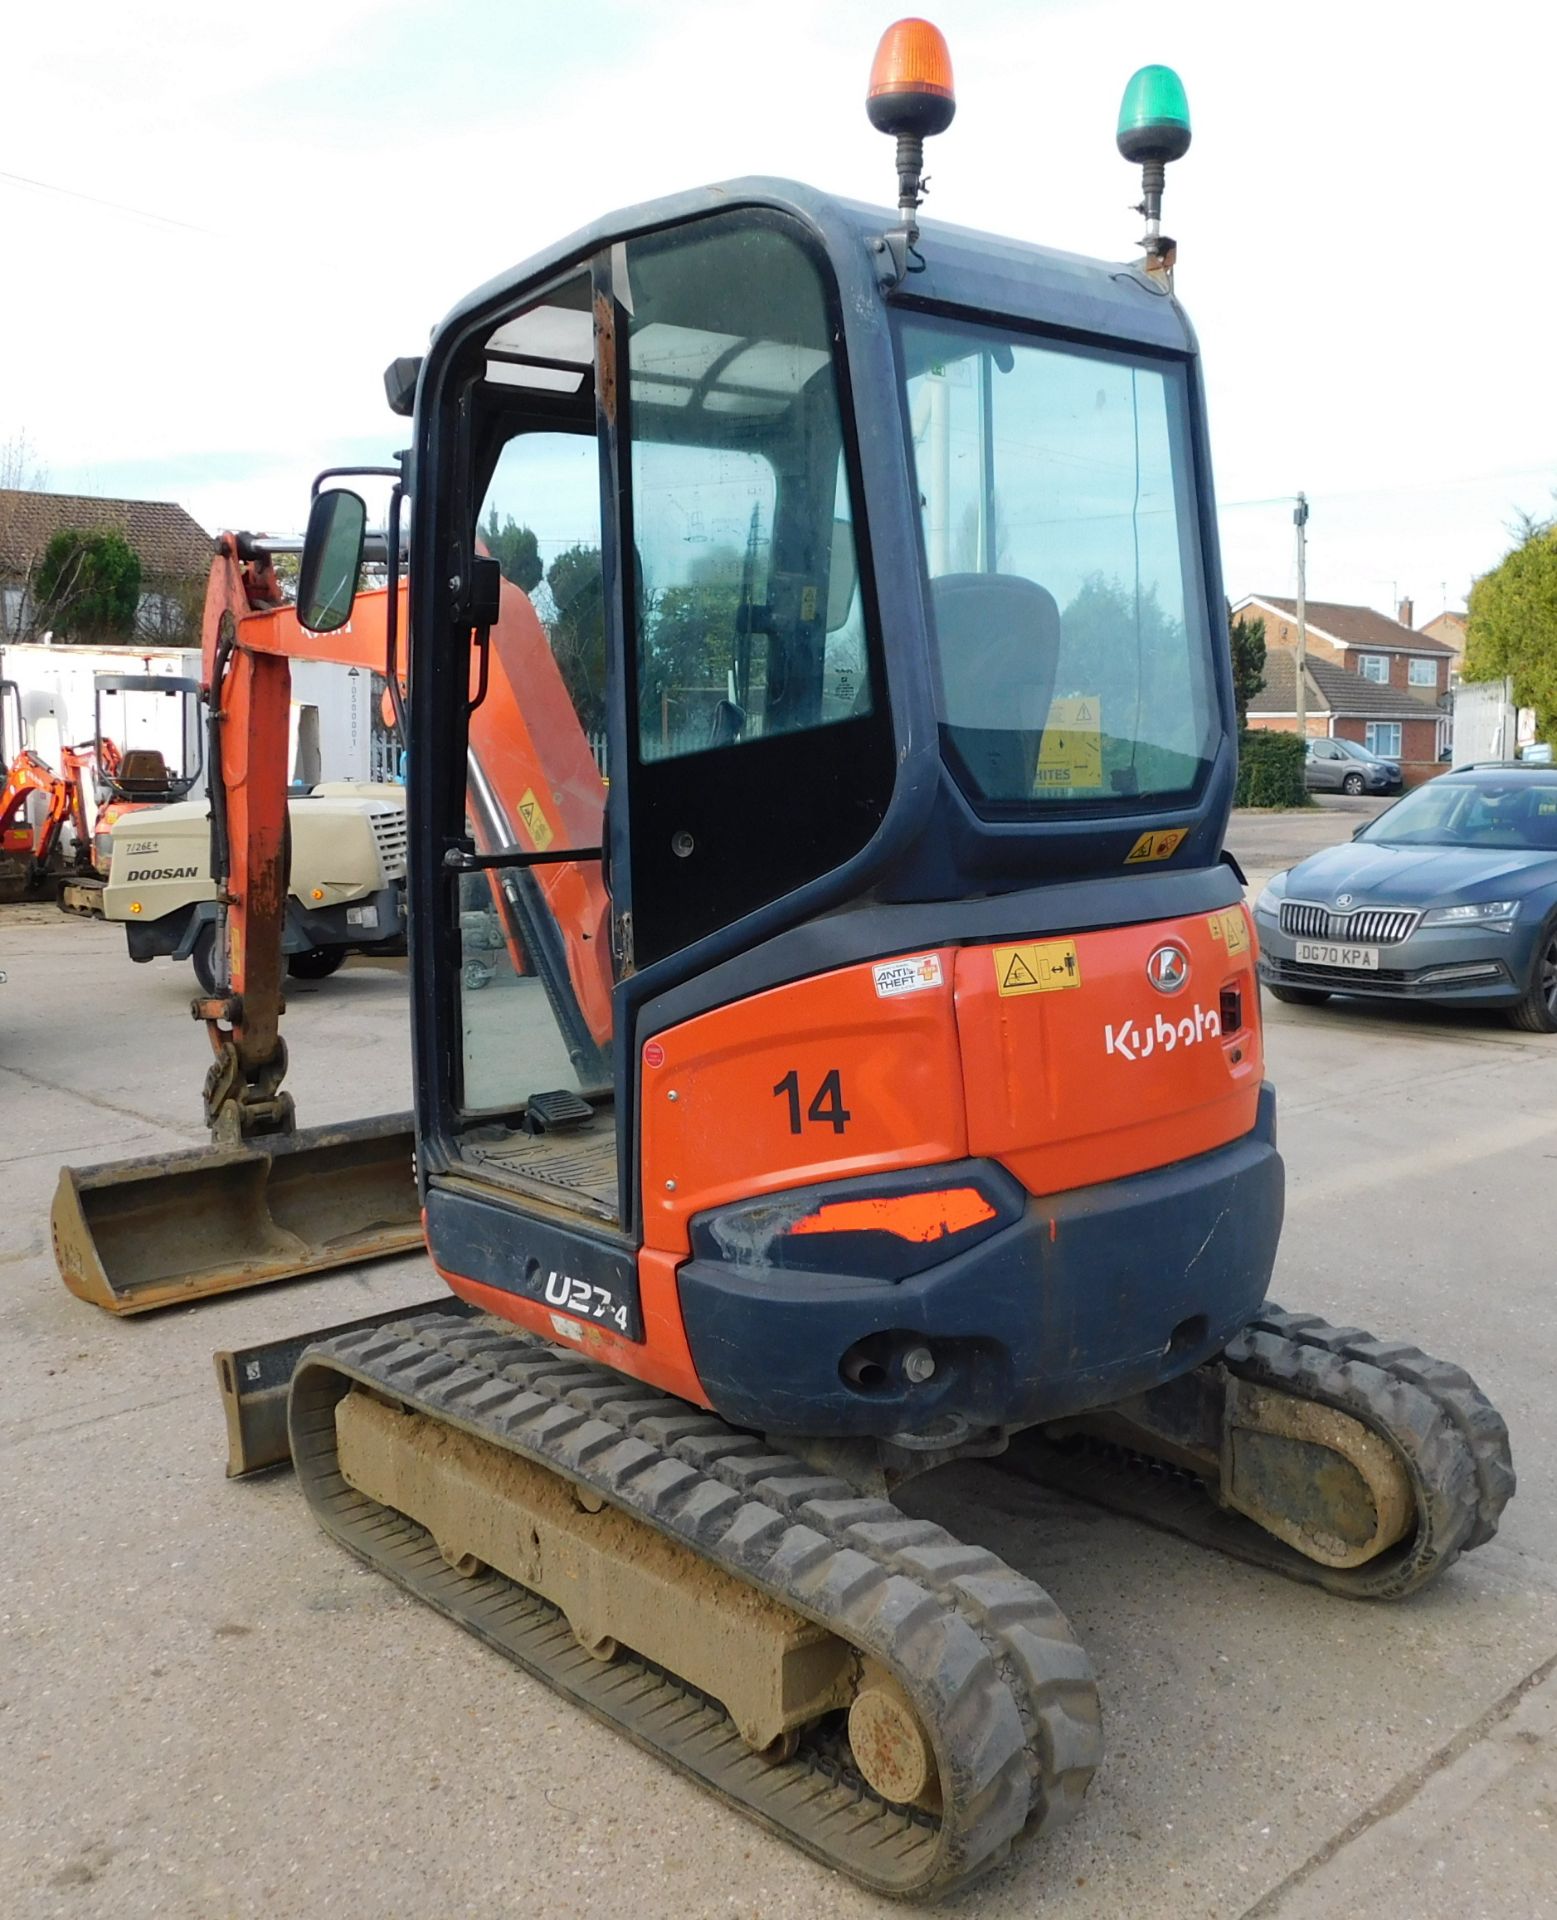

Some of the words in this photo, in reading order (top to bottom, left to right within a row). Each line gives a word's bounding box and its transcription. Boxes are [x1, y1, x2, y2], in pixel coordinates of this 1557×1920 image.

[1036, 768, 1071, 781] HITES
[127, 866, 198, 881] DOOSAN
[1302, 945, 1338, 963] DG70
[1342, 948, 1371, 966] KPA
[877, 976, 915, 991] THEFT
[1104, 1003, 1221, 1061] Kubota
[773, 1069, 851, 1135] 14
